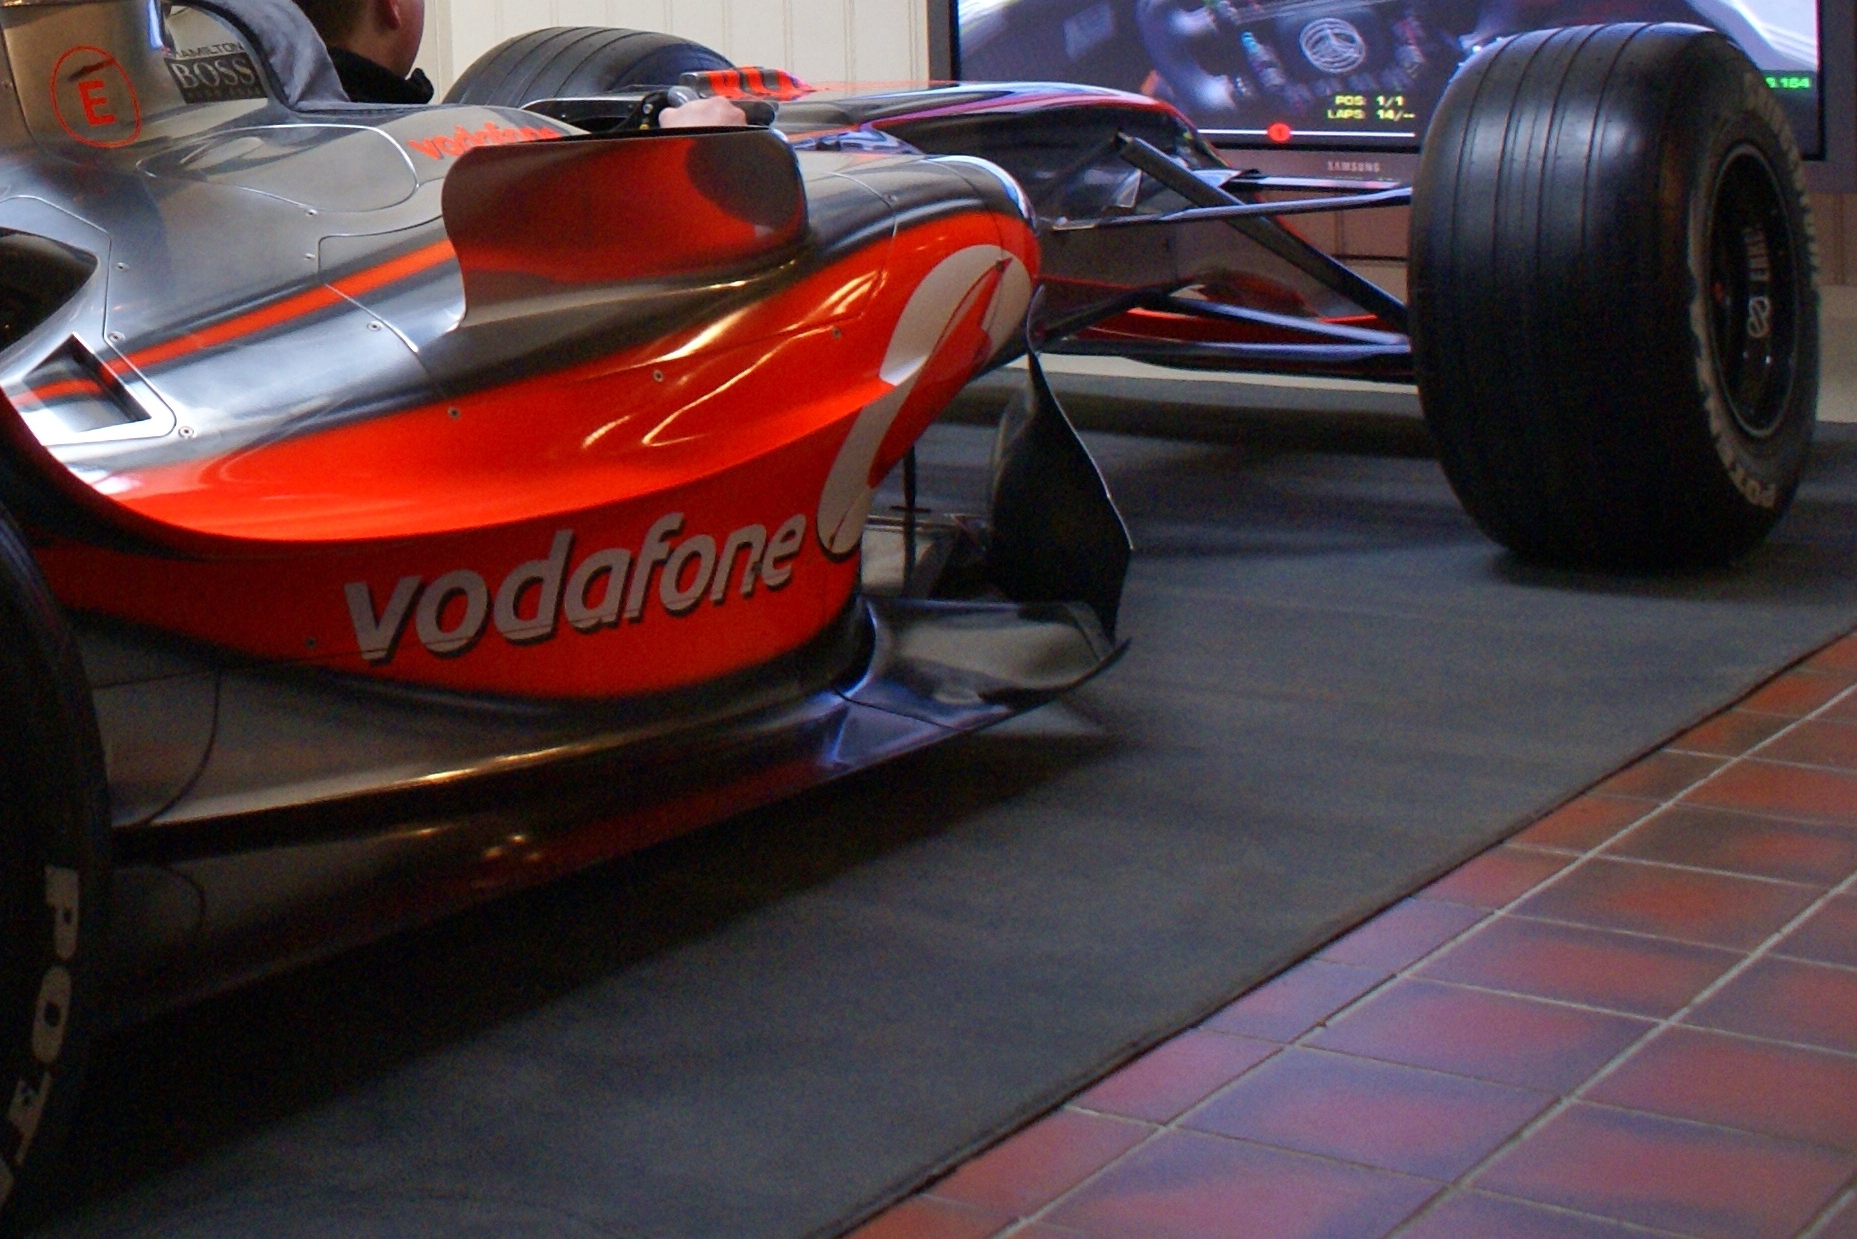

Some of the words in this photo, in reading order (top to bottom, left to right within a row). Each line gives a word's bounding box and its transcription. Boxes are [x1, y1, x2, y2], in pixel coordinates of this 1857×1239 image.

[171, 57, 255, 88] BOSS
[78, 79, 116, 127] E
[346, 511, 808, 662] vodafone
